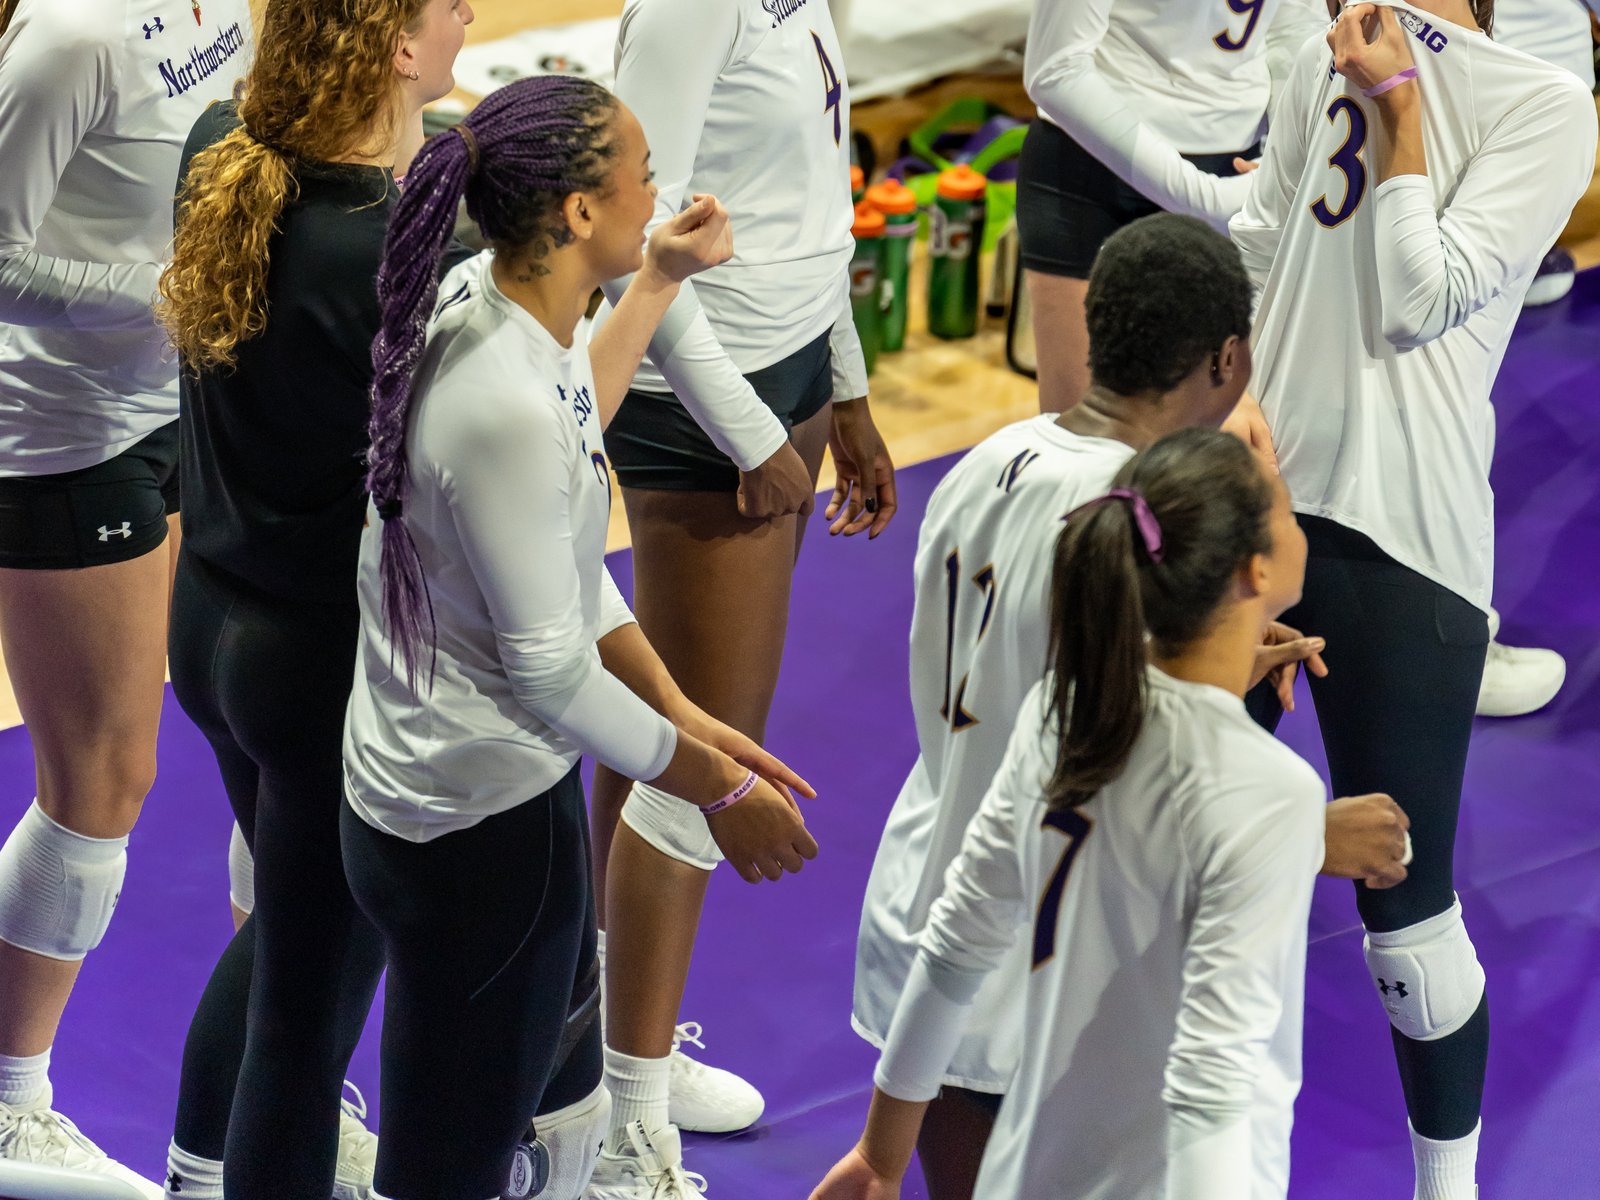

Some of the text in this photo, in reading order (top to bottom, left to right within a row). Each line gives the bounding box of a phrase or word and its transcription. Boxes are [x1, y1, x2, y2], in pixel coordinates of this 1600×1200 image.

[157, 22, 244, 98] Northwestern
[809, 29, 842, 149] 4
[1309, 94, 1369, 230] 3
[996, 448, 1040, 494] N
[939, 546, 996, 734] 12
[1031, 806, 1094, 972] 7
